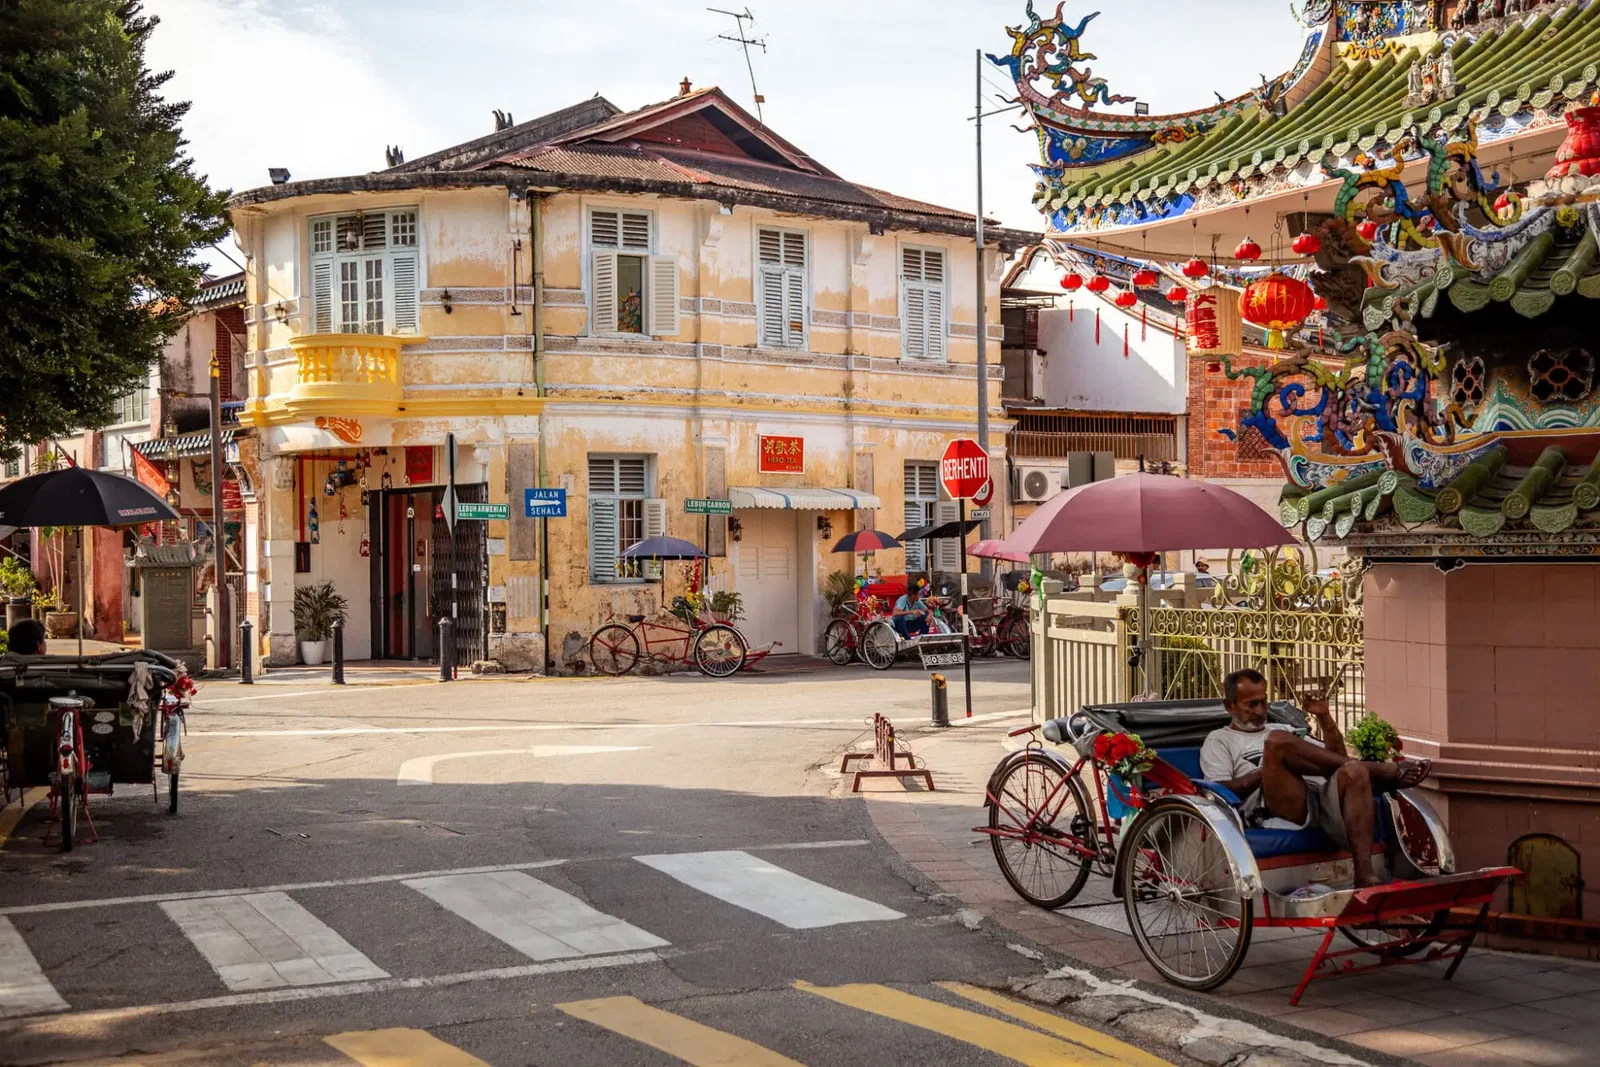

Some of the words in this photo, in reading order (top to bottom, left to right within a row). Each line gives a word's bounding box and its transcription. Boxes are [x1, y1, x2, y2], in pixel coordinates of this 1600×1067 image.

[943, 456, 986, 481] BERHENTI
[534, 490, 559, 499] JALAN
[458, 505, 477, 513] LEBUH
[477, 505, 507, 513] ARMENIAN
[687, 500, 707, 508] LEBUH
[707, 501, 731, 509] CANNON
[530, 506, 562, 515] SEHALA
